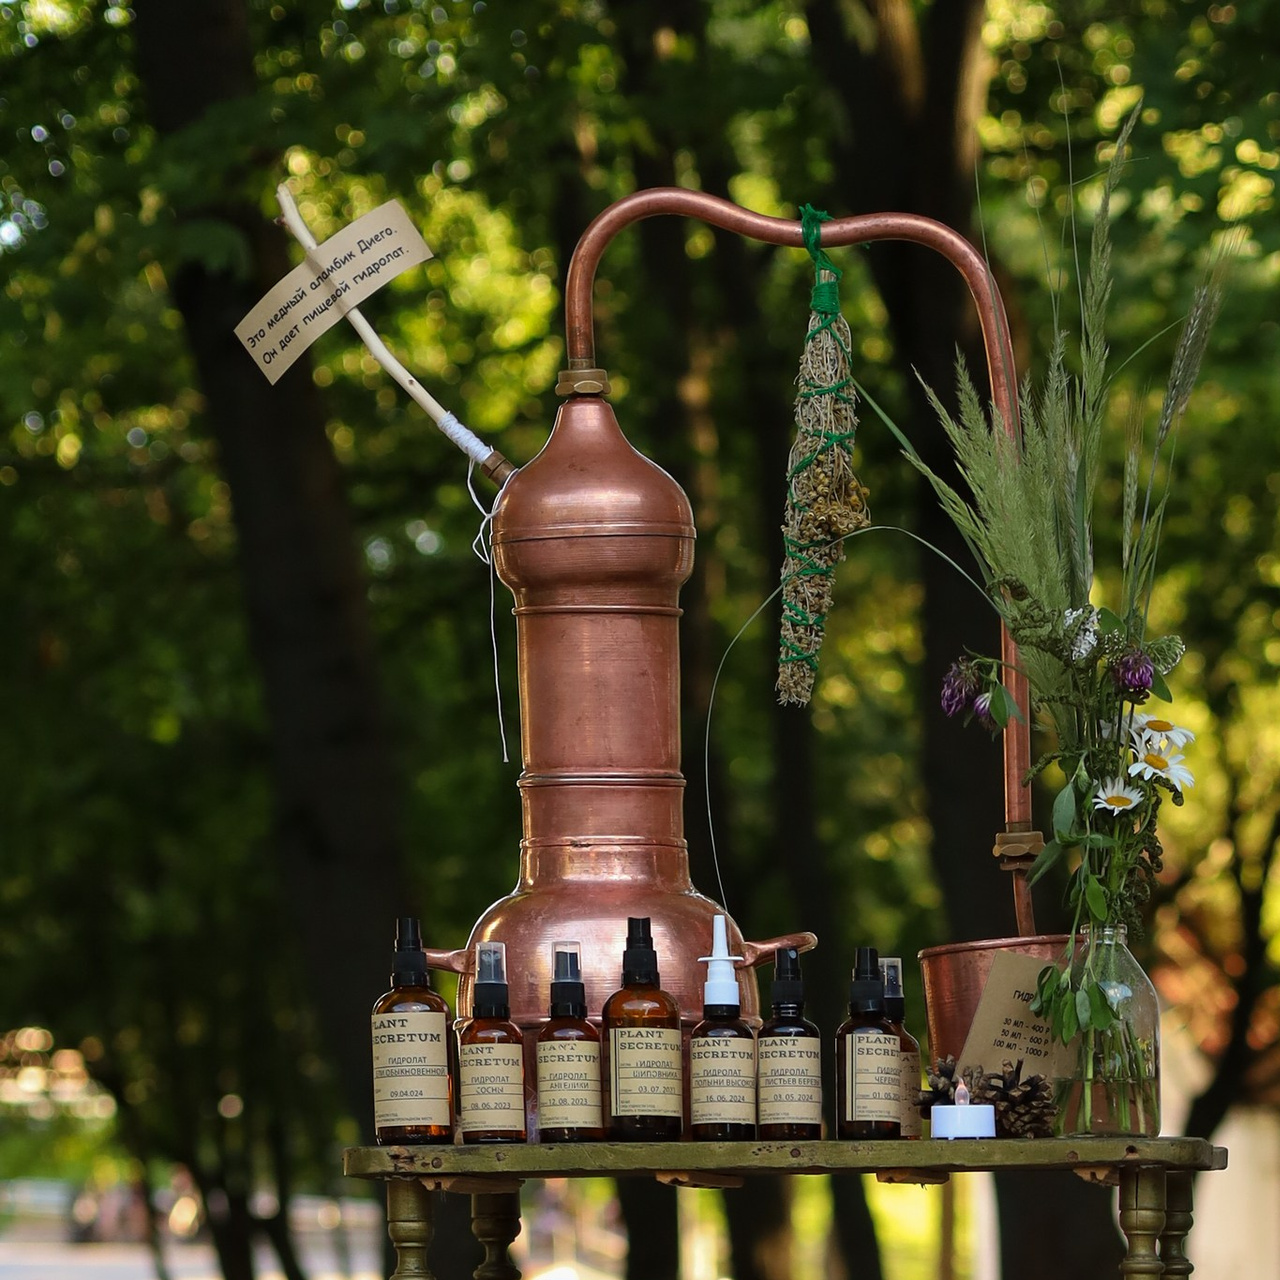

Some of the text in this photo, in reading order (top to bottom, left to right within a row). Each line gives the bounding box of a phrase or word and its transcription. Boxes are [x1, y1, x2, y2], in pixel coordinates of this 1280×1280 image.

[247, 226, 398, 348] Это медный аламбик Диего.
[263, 246, 409, 364] Он дает пищевой гидролат.
[373, 1019, 408, 1029] LANT
[1013, 1020, 1024, 1028] МЛ
[1031, 1025, 1044, 1033] 400
[373, 1034, 441, 1044] ECRETUM
[857, 1036, 897, 1045] PLANT
[1010, 1031, 1021, 1039] МЛ
[1030, 1036, 1042, 1044] 600
[692, 1039, 731, 1048] PLANT
[759, 1039, 799, 1047] PLANT
[993, 1039, 1042, 1056] 100 МЛ 1000
[692, 1051, 753, 1060] SECRETUM
[760, 1051, 819, 1059] SECRETUM
[857, 1048, 900, 1057] SECRET
[538, 1055, 599, 1063] SECRETUM
